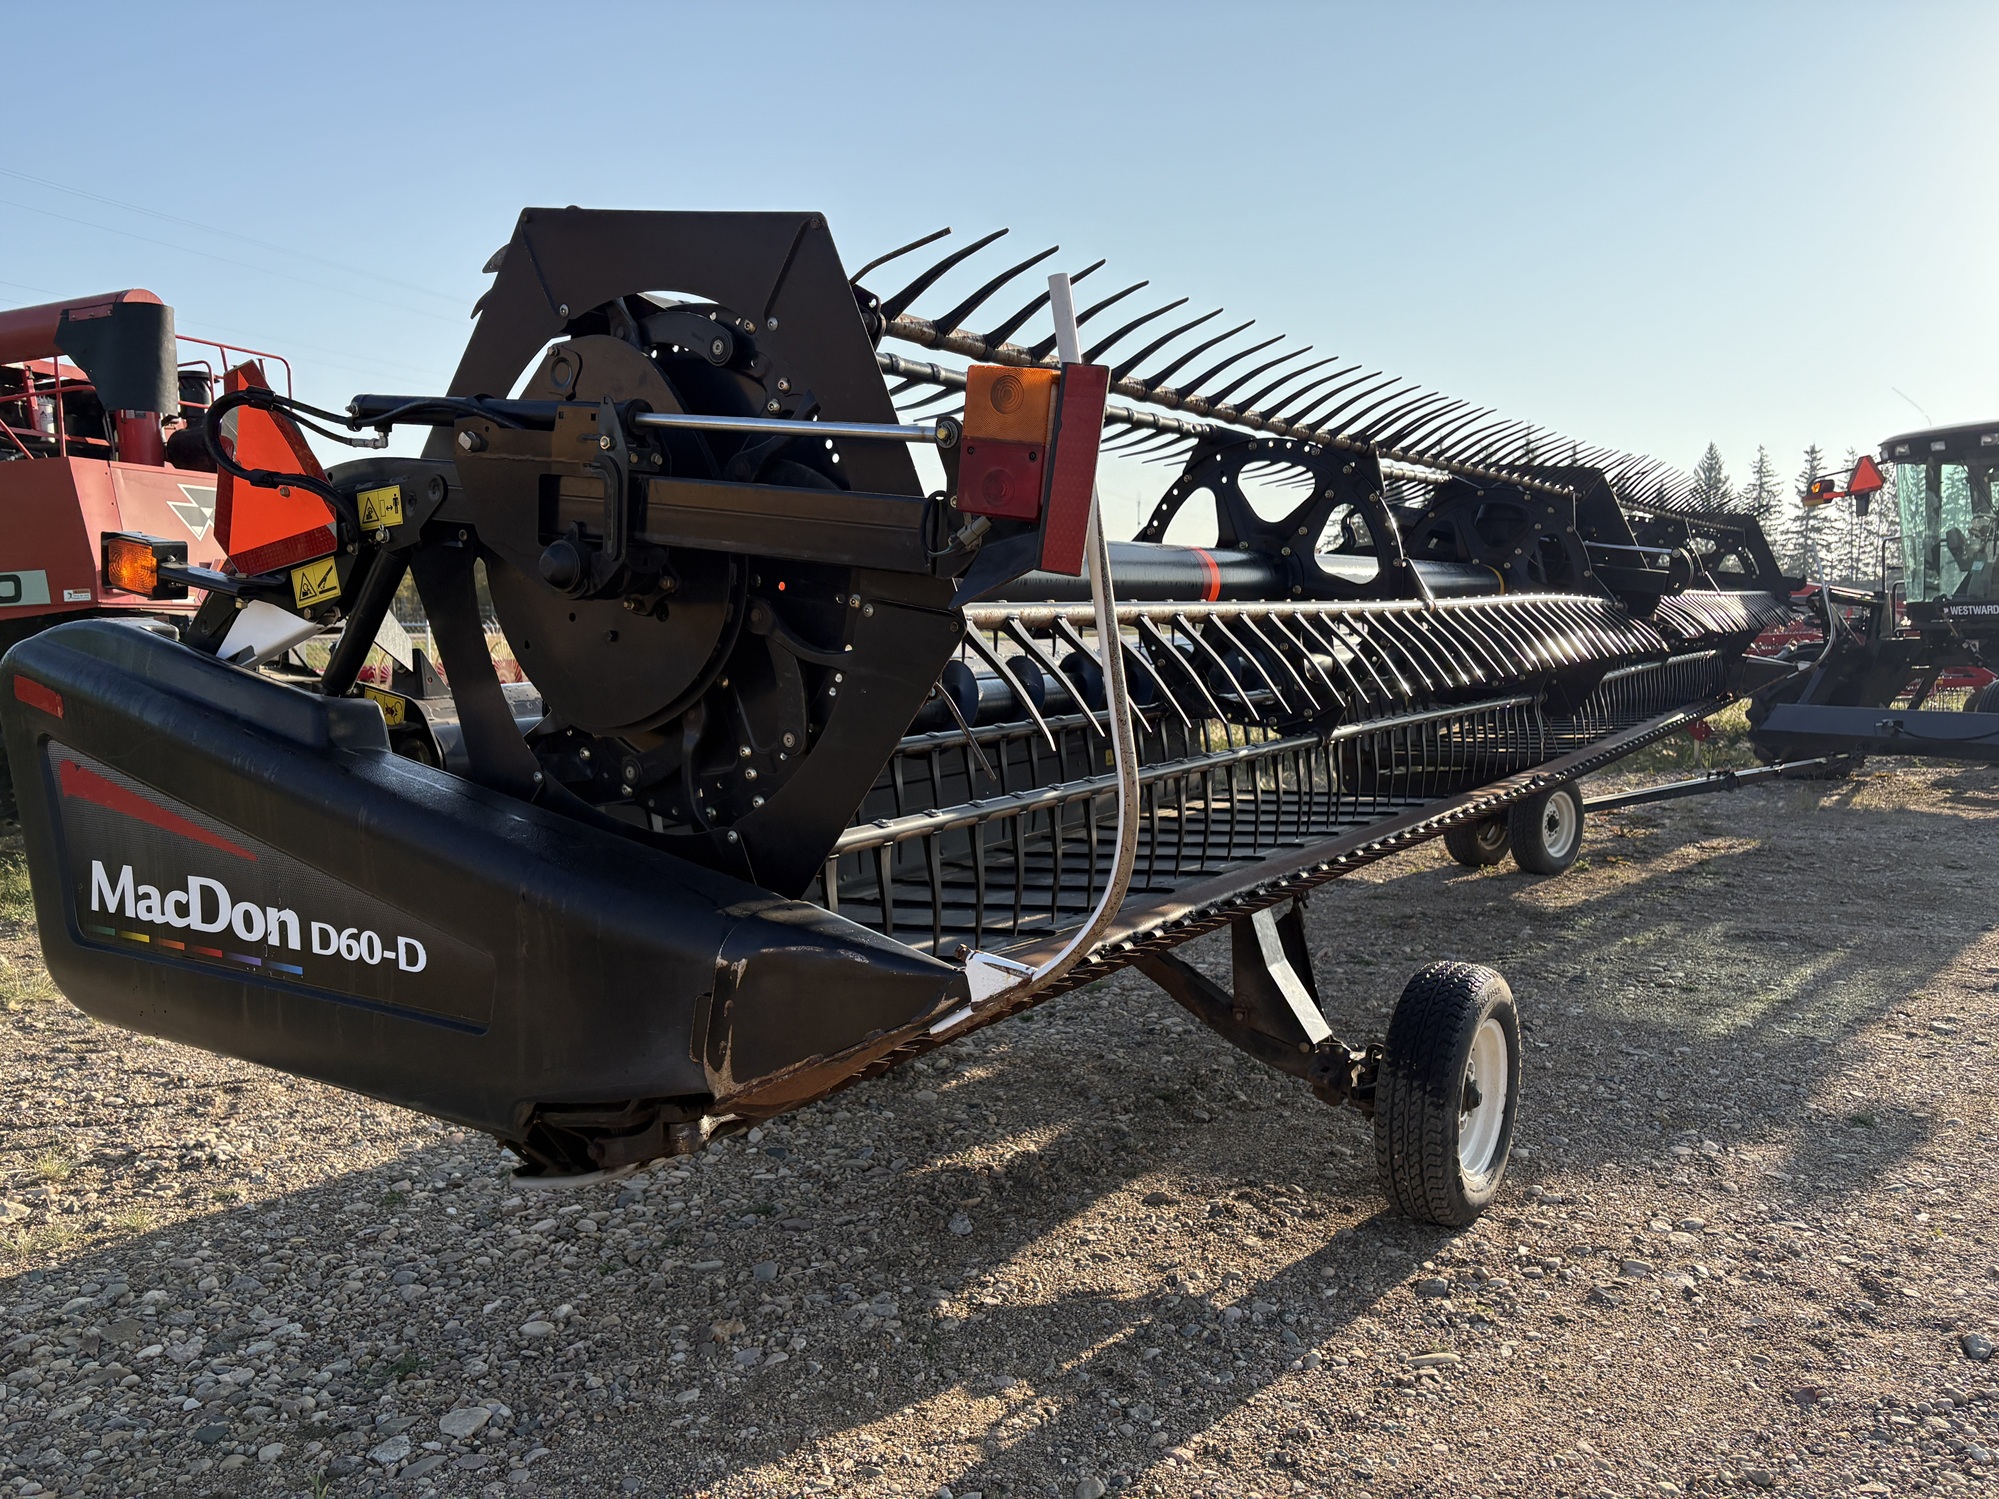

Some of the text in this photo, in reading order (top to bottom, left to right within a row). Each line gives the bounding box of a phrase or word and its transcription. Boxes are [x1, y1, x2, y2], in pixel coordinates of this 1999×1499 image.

[1950, 604, 1999, 615] WESTWARD
[91, 859, 427, 973] MacDon D60-D
